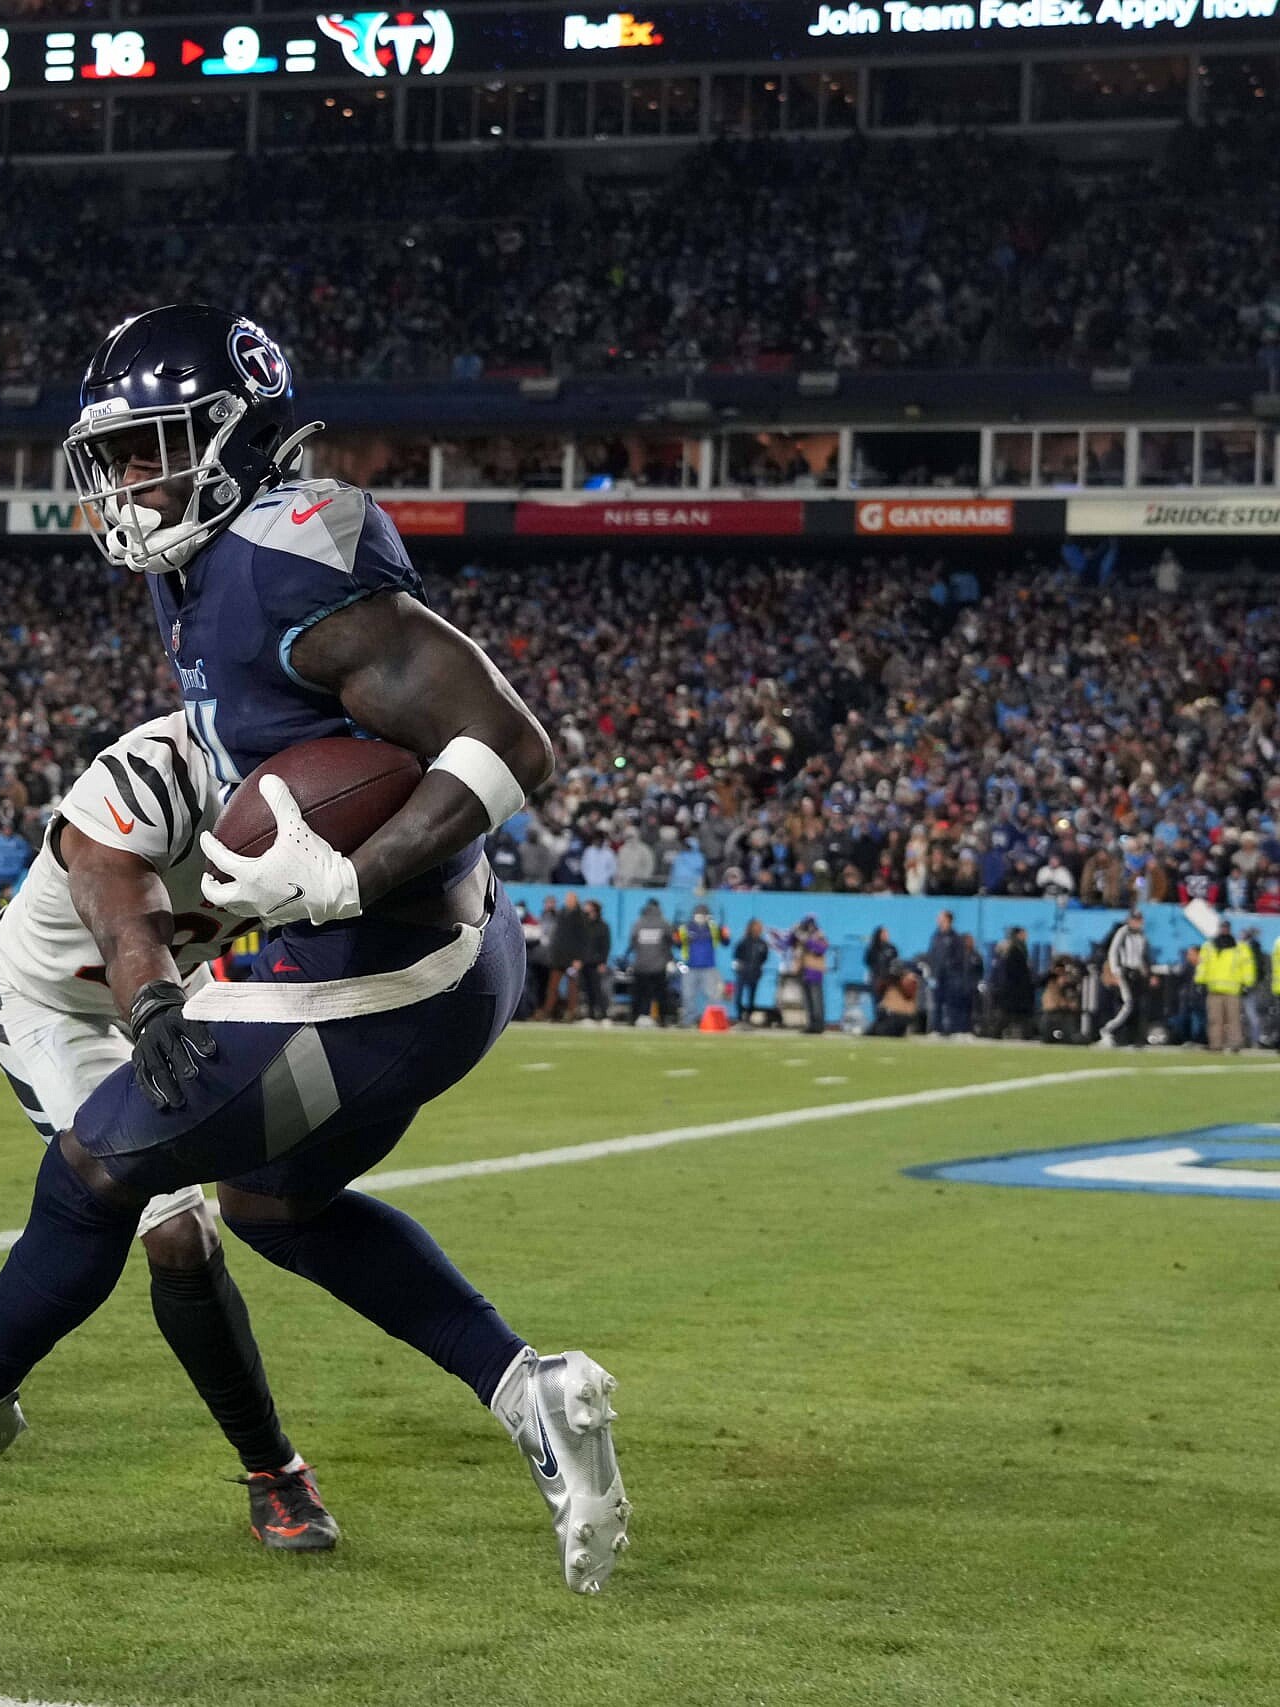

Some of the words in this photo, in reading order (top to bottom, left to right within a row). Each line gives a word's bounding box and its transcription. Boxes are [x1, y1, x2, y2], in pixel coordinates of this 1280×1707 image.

[808, 2, 880, 36] Join
[884, 1, 975, 32] Team
[979, 0, 1092, 29] FedEx.
[1096, 0, 1199, 30] Apply
[1202, 0, 1280, 20] now
[91, 31, 145, 76] 16
[222, 26, 260, 71] 9
[604, 508, 710, 526] NISSAN
[888, 506, 1009, 528] GATORADE
